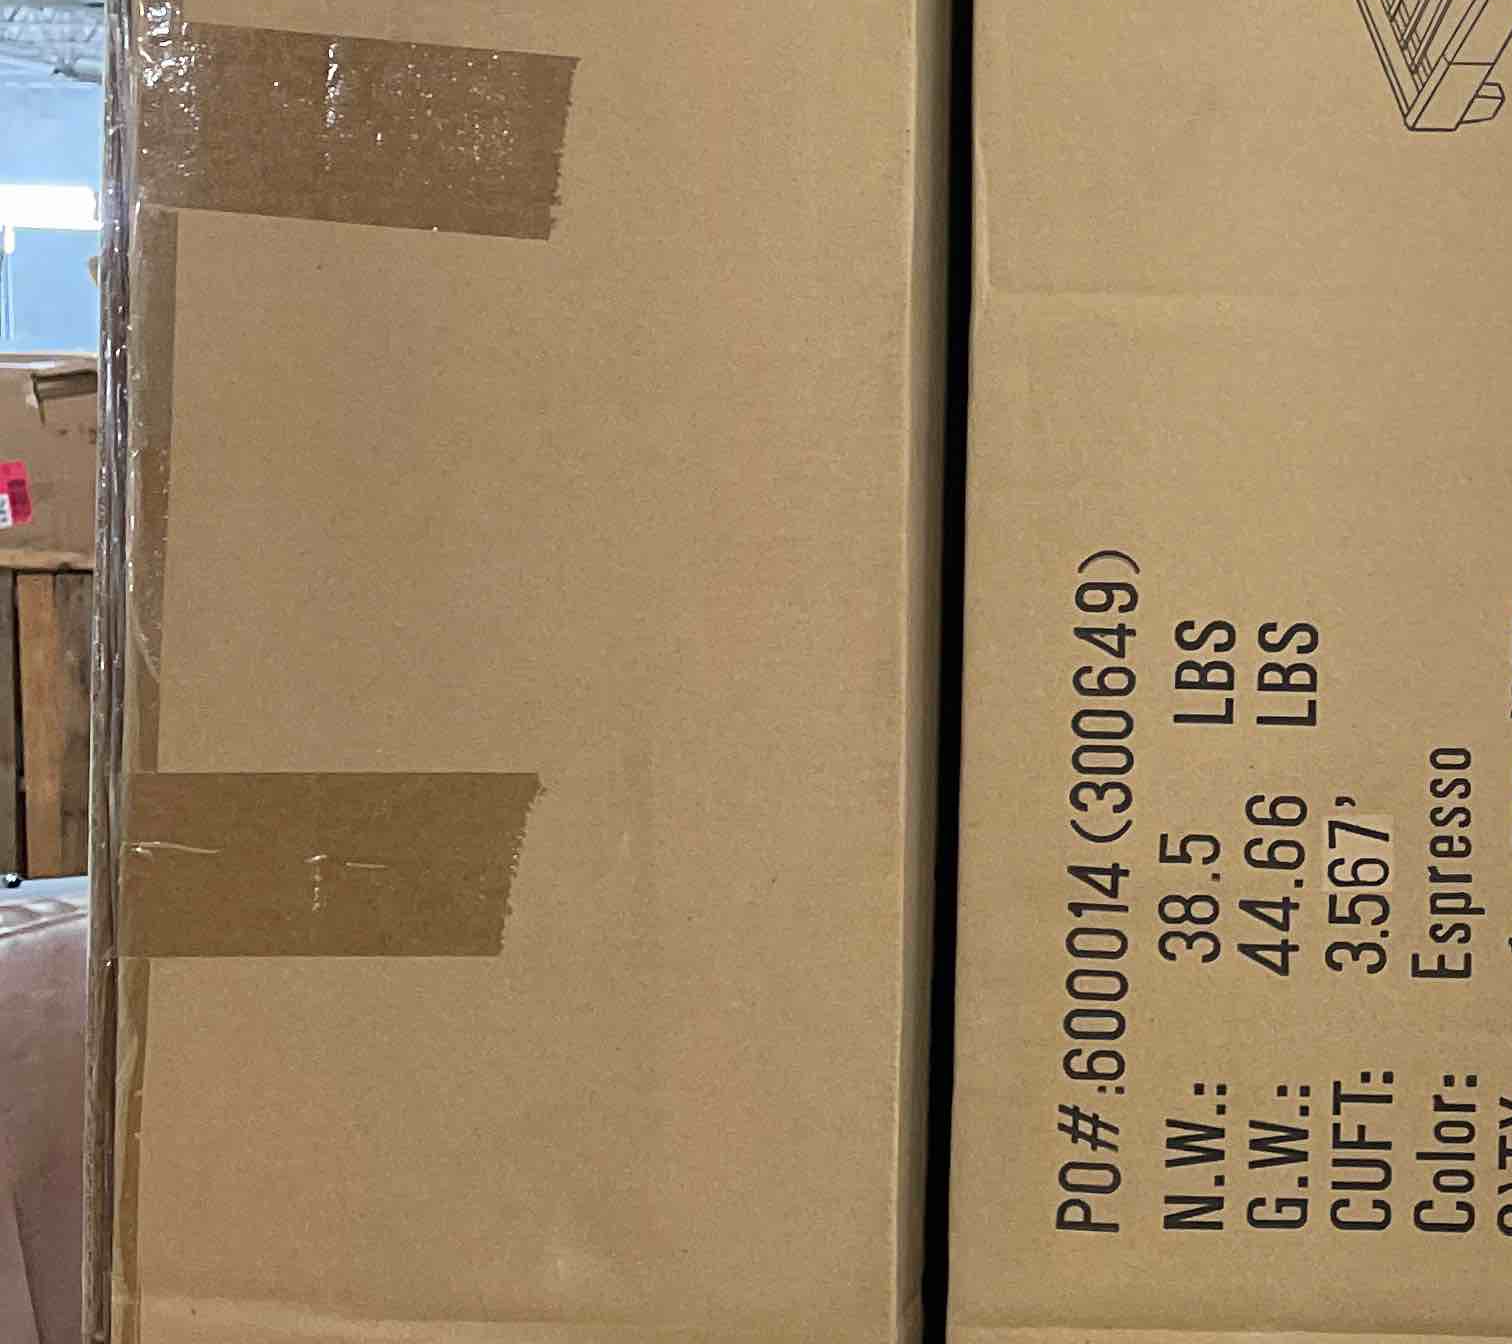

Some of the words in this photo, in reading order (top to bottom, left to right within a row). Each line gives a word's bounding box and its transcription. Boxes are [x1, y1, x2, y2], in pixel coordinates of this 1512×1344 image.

[1172, 618, 1238, 726] LBS
[1255, 621, 1319, 727] LBS
[1158, 832, 1222, 964] 38.5
[1238, 794, 1308, 977] 44.66
[1410, 747, 1485, 979] Espresso
[1162, 1082, 1227, 1232] N.W.:
[1246, 1084, 1311, 1231] G.W.:
[1329, 1070, 1395, 1232] CUFT:
[1412, 1072, 1478, 1233] Color:
